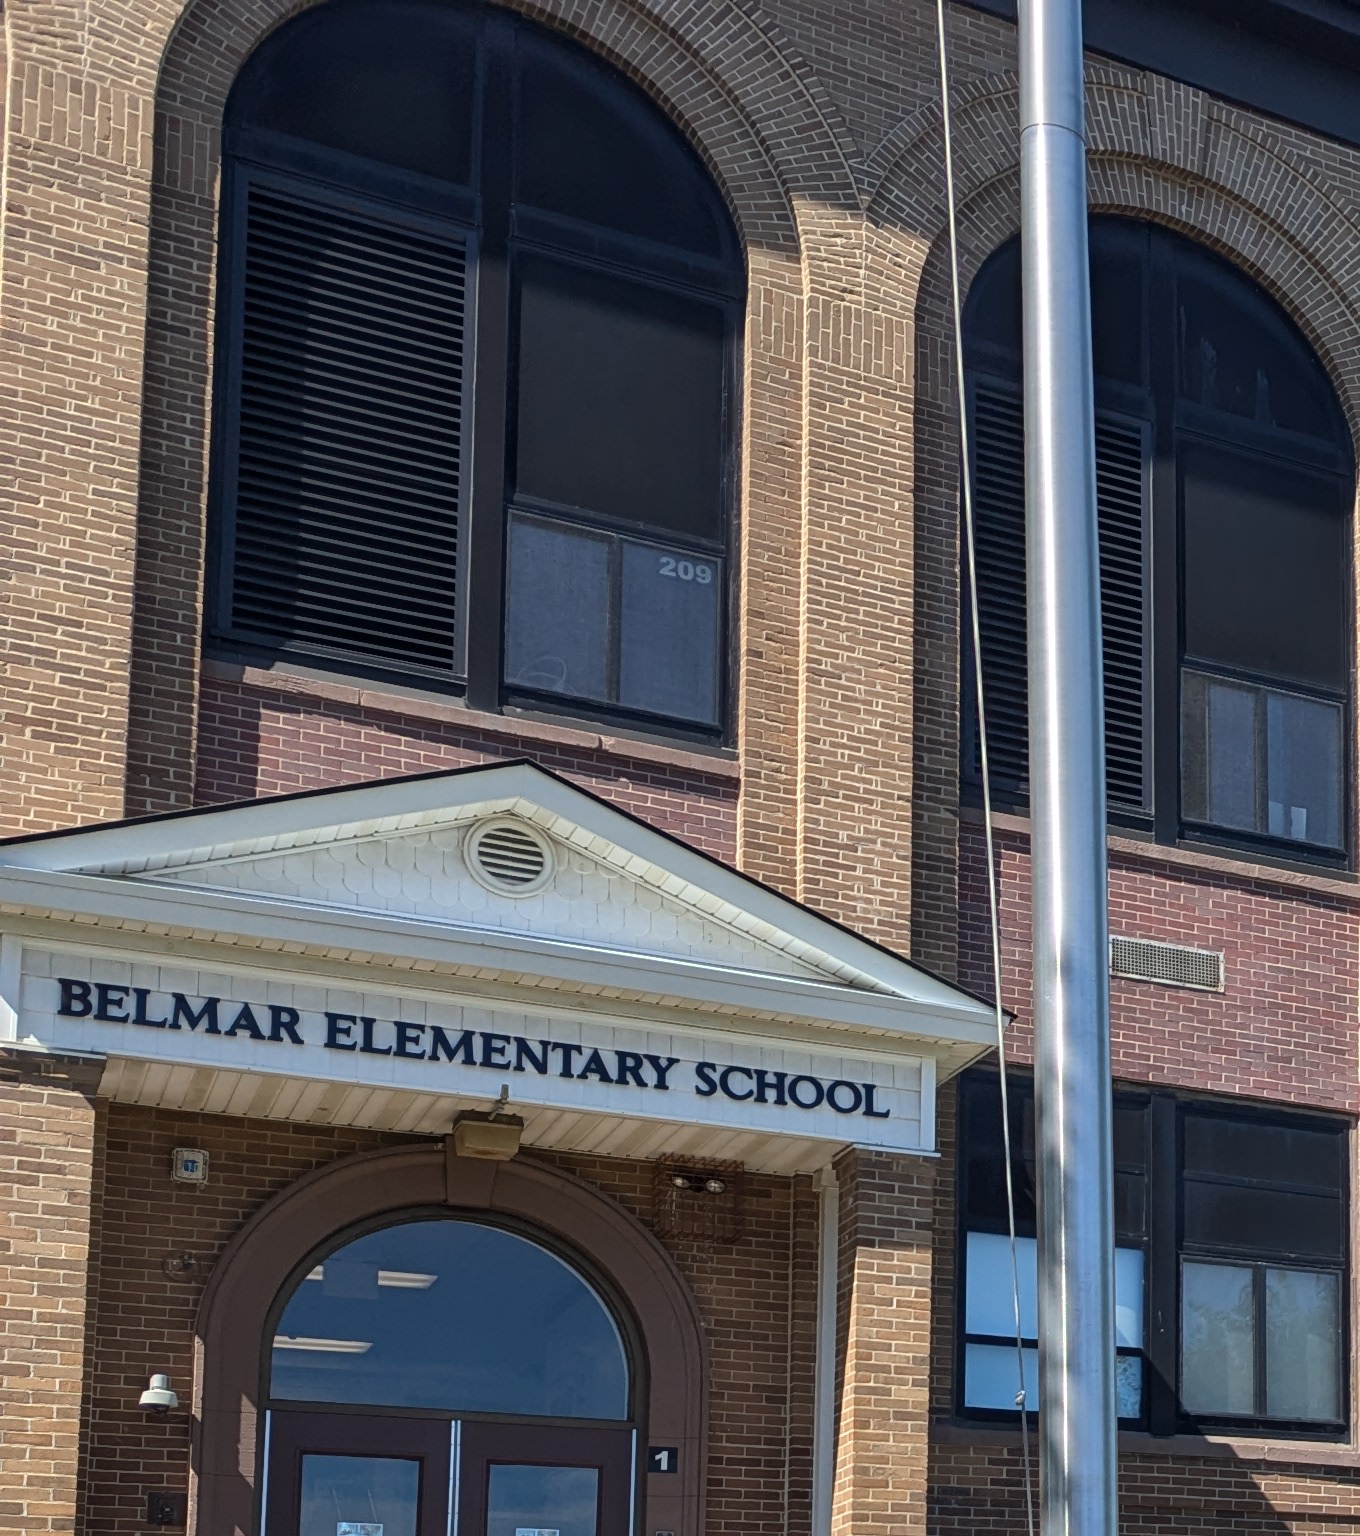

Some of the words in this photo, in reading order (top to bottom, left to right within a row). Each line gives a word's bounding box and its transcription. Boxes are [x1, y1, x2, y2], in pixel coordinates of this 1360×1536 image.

[659, 556, 712, 584] 209
[57, 977, 305, 1045] BELMAR
[323, 1011, 681, 1091] ELEMENTARY
[694, 1061, 891, 1119] SCHOOL
[654, 1450, 669, 1471] 1
